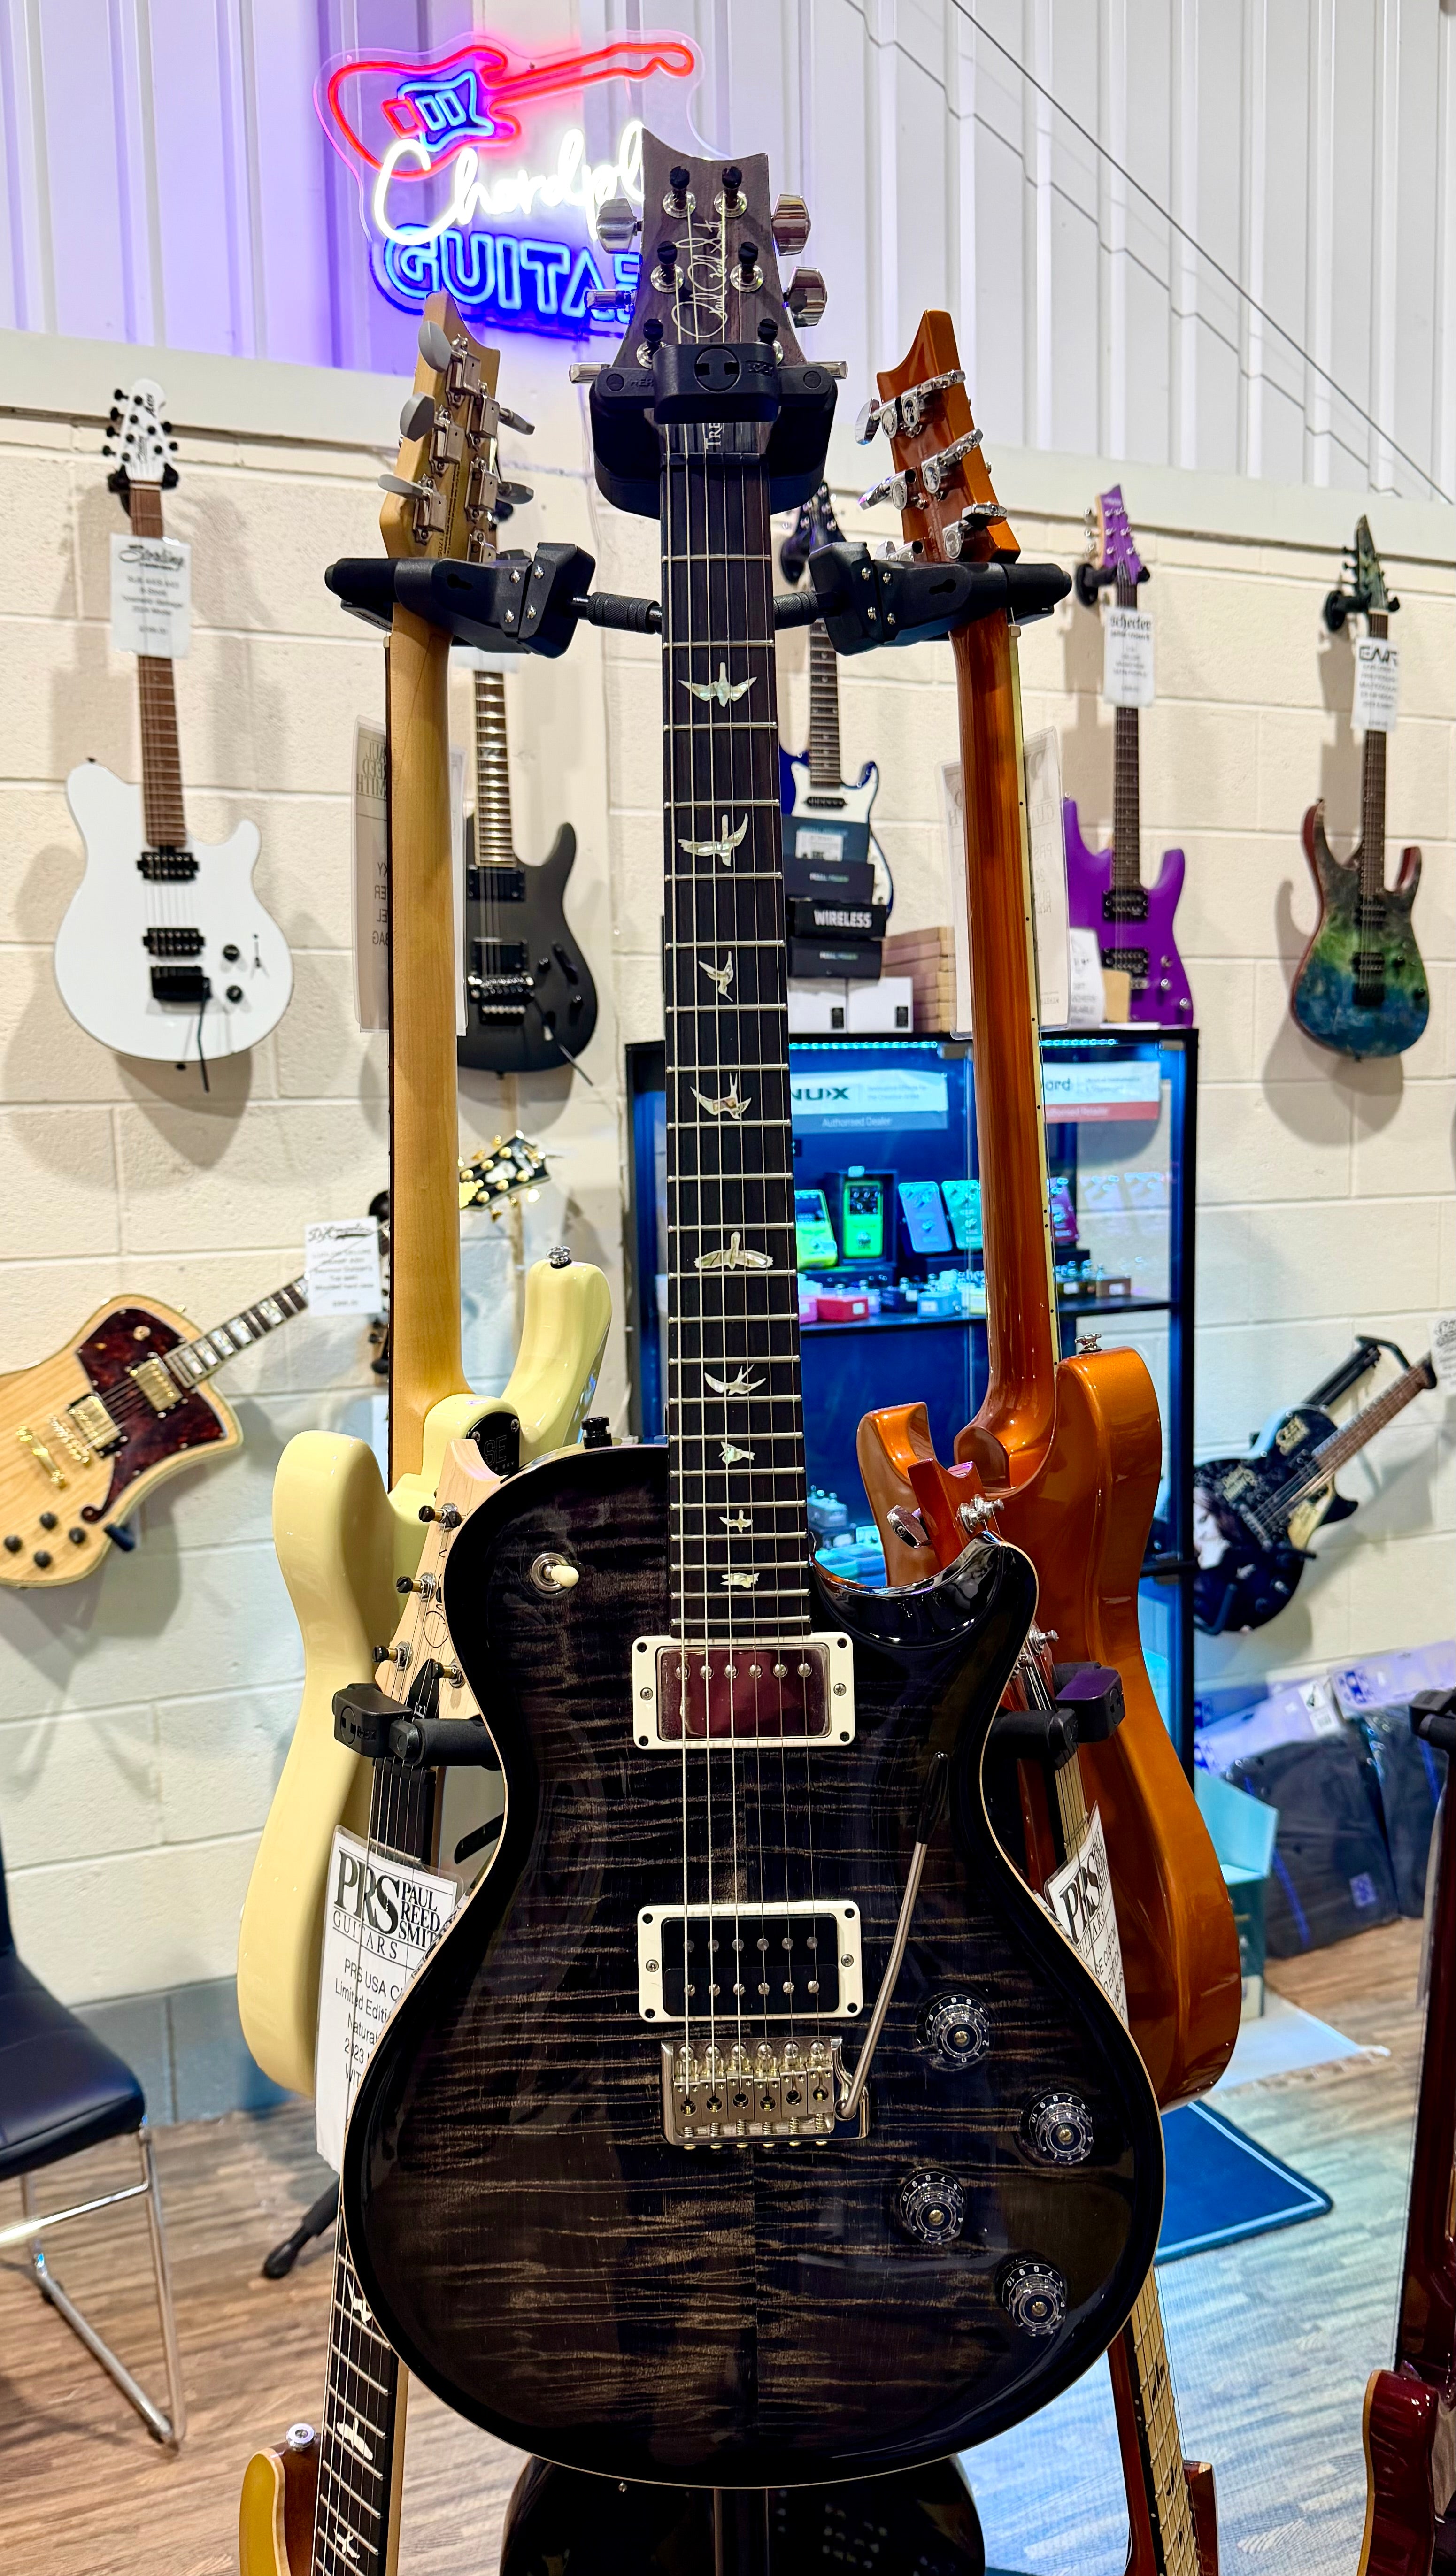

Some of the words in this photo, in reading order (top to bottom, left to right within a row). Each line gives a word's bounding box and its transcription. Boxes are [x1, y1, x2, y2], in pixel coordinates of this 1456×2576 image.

[374, 121, 645, 245] Chordpl
[631, 378, 654, 387] HER
[705, 423, 722, 450] TRE
[814, 909, 871, 928] WIRELESS
[1045, 1078, 1071, 1092] ard
[333, 1849, 400, 1934] PRS
[401, 1881, 438, 1912] PAUL
[1059, 1851, 1101, 1946] PRS
[401, 1901, 440, 1932] REED
[333, 1910, 398, 1960] GUITARS
[398, 1919, 438, 1948] SMIT
[344, 1958, 363, 1983] PRS
[365, 1971, 386, 1998] USA
[390, 1985, 403, 2002] C
[335, 1978, 363, 2011] Limited
[366, 1998, 392, 2023] Editi
[344, 2037, 364, 2064] 2023
[345, 2062, 362, 2089] WIT
